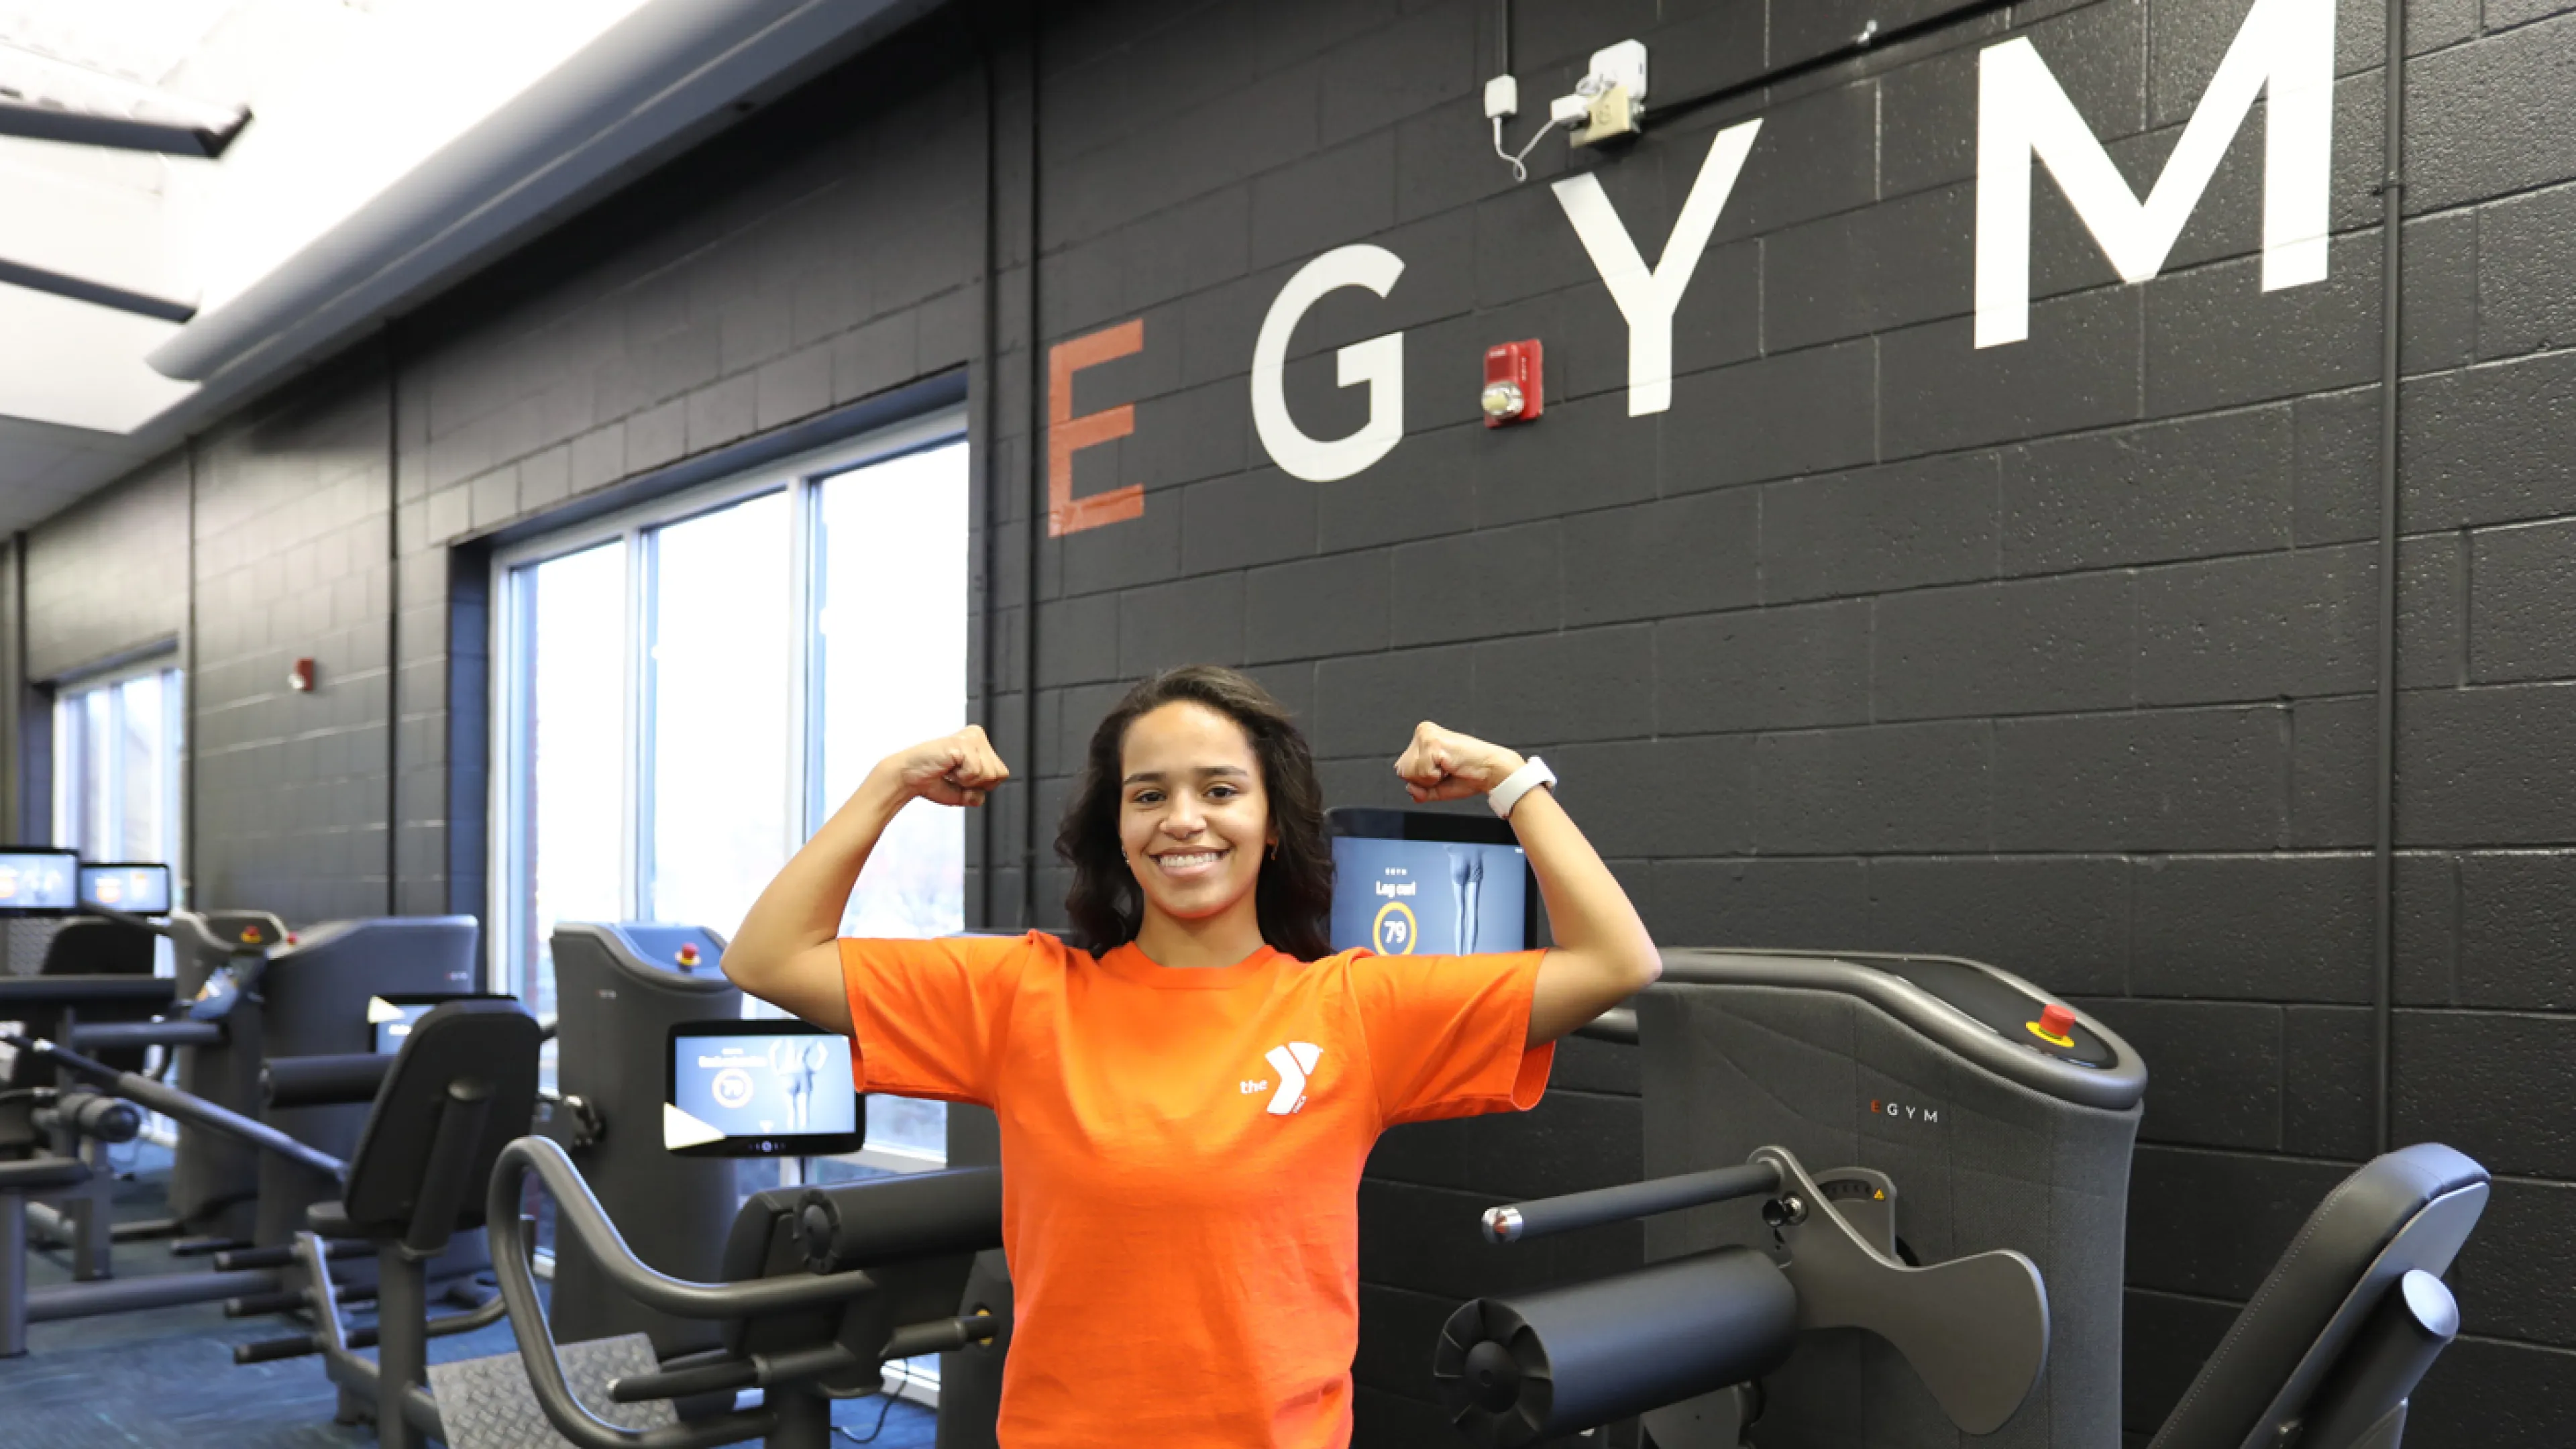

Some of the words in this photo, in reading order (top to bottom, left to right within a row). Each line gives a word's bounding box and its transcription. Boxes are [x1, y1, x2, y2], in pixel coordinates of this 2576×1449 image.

[1049, 0, 2336, 538] EGYM
[1384, 920, 1406, 943] 79
[1240, 1079, 1268, 1095] the
[1870, 1099, 1938, 1123] EGYM
